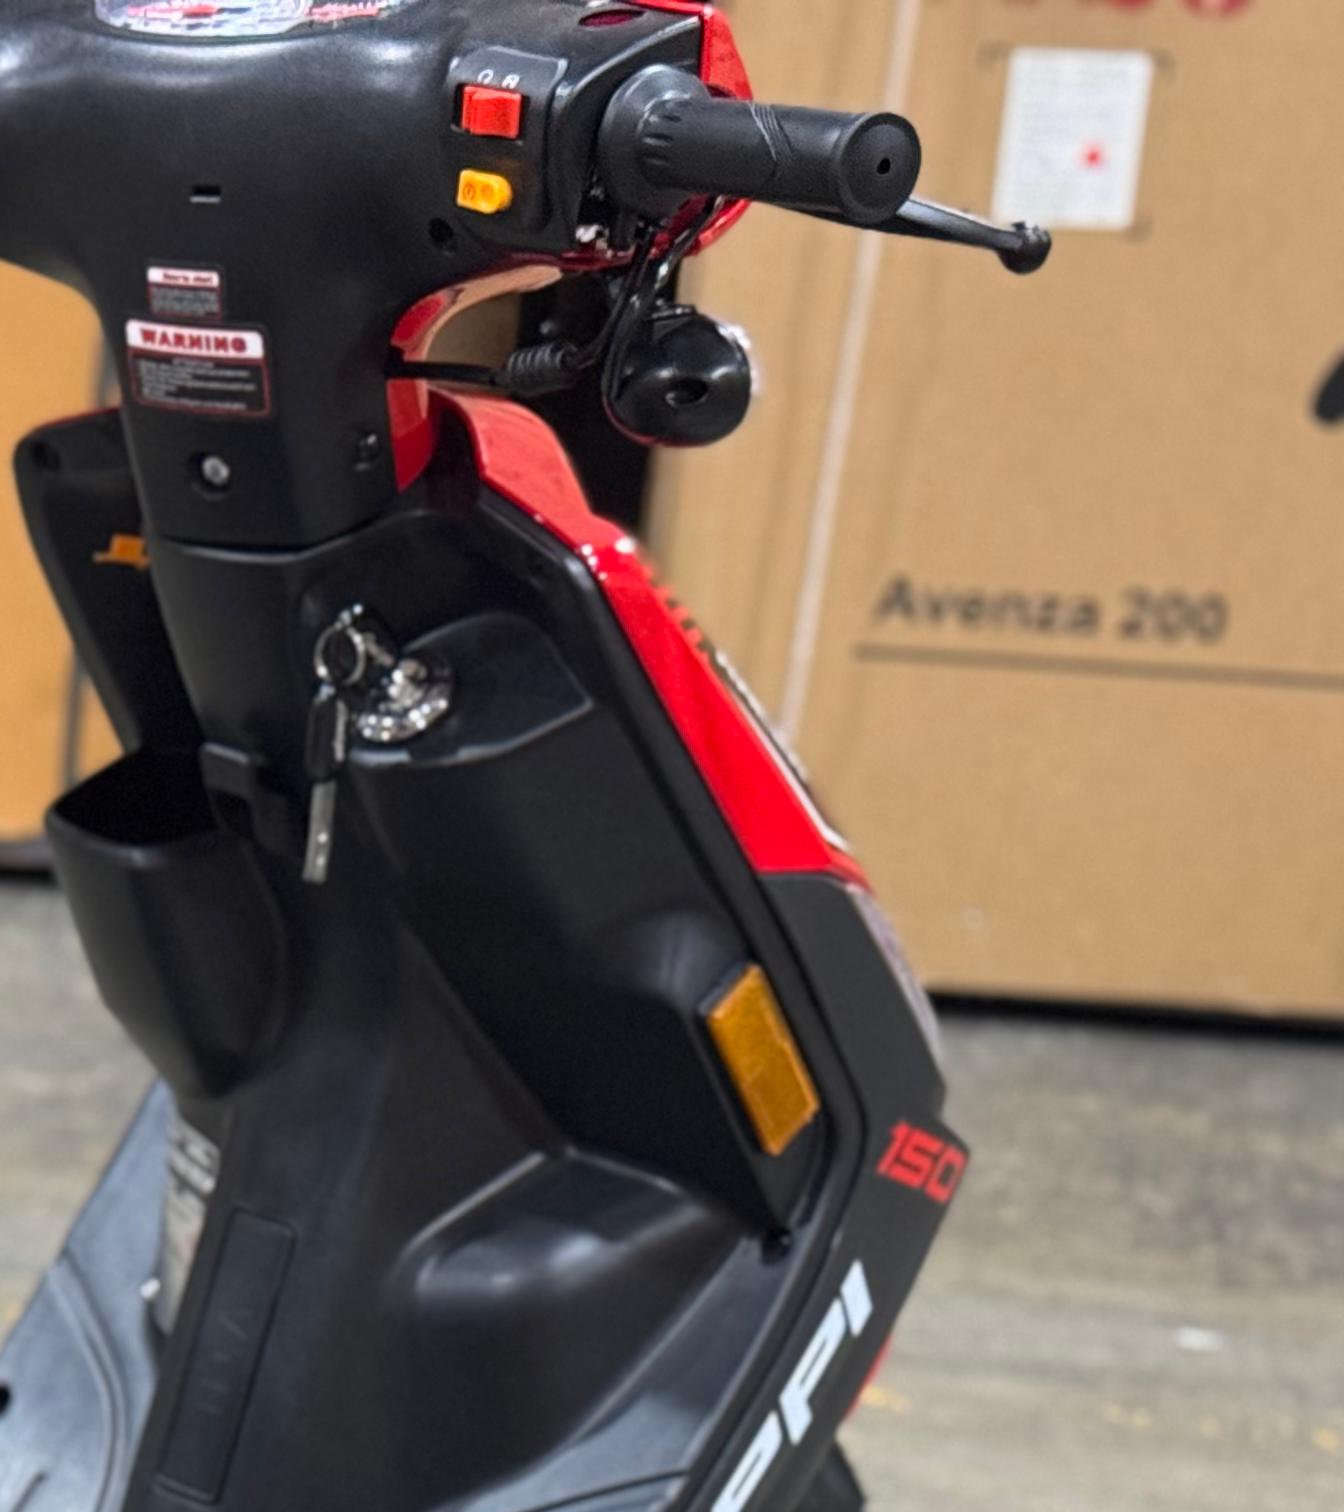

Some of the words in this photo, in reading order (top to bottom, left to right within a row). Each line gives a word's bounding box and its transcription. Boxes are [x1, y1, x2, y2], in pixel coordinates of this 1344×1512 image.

[140, 327, 248, 353] WARNING
[875, 570, 1100, 636] Avenza
[1120, 584, 1231, 646] 200
[876, 1120, 968, 1206] 150
